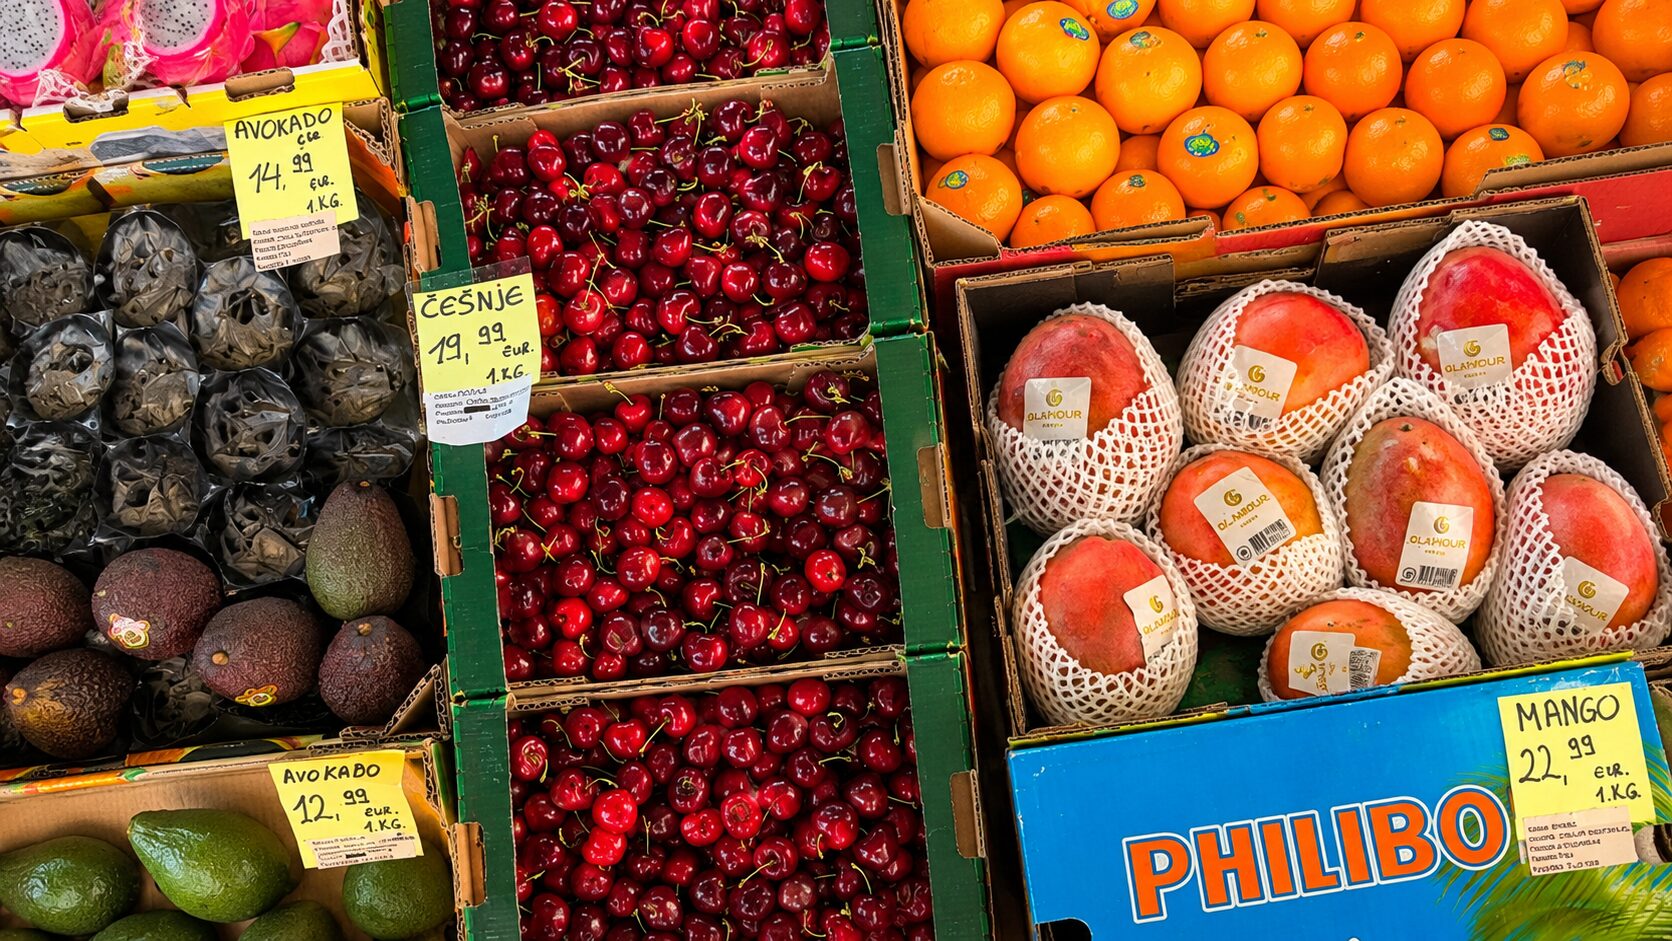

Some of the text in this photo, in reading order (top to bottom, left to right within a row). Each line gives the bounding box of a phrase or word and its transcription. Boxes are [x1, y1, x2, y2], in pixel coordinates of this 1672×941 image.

[234, 107, 333, 140] AVOKADO
[502, 341, 535, 358] EUR.
[1516, 694, 1621, 732] MANGO
[1593, 762, 1630, 779] EUR.
[1122, 784, 1512, 924] PHILIBO
